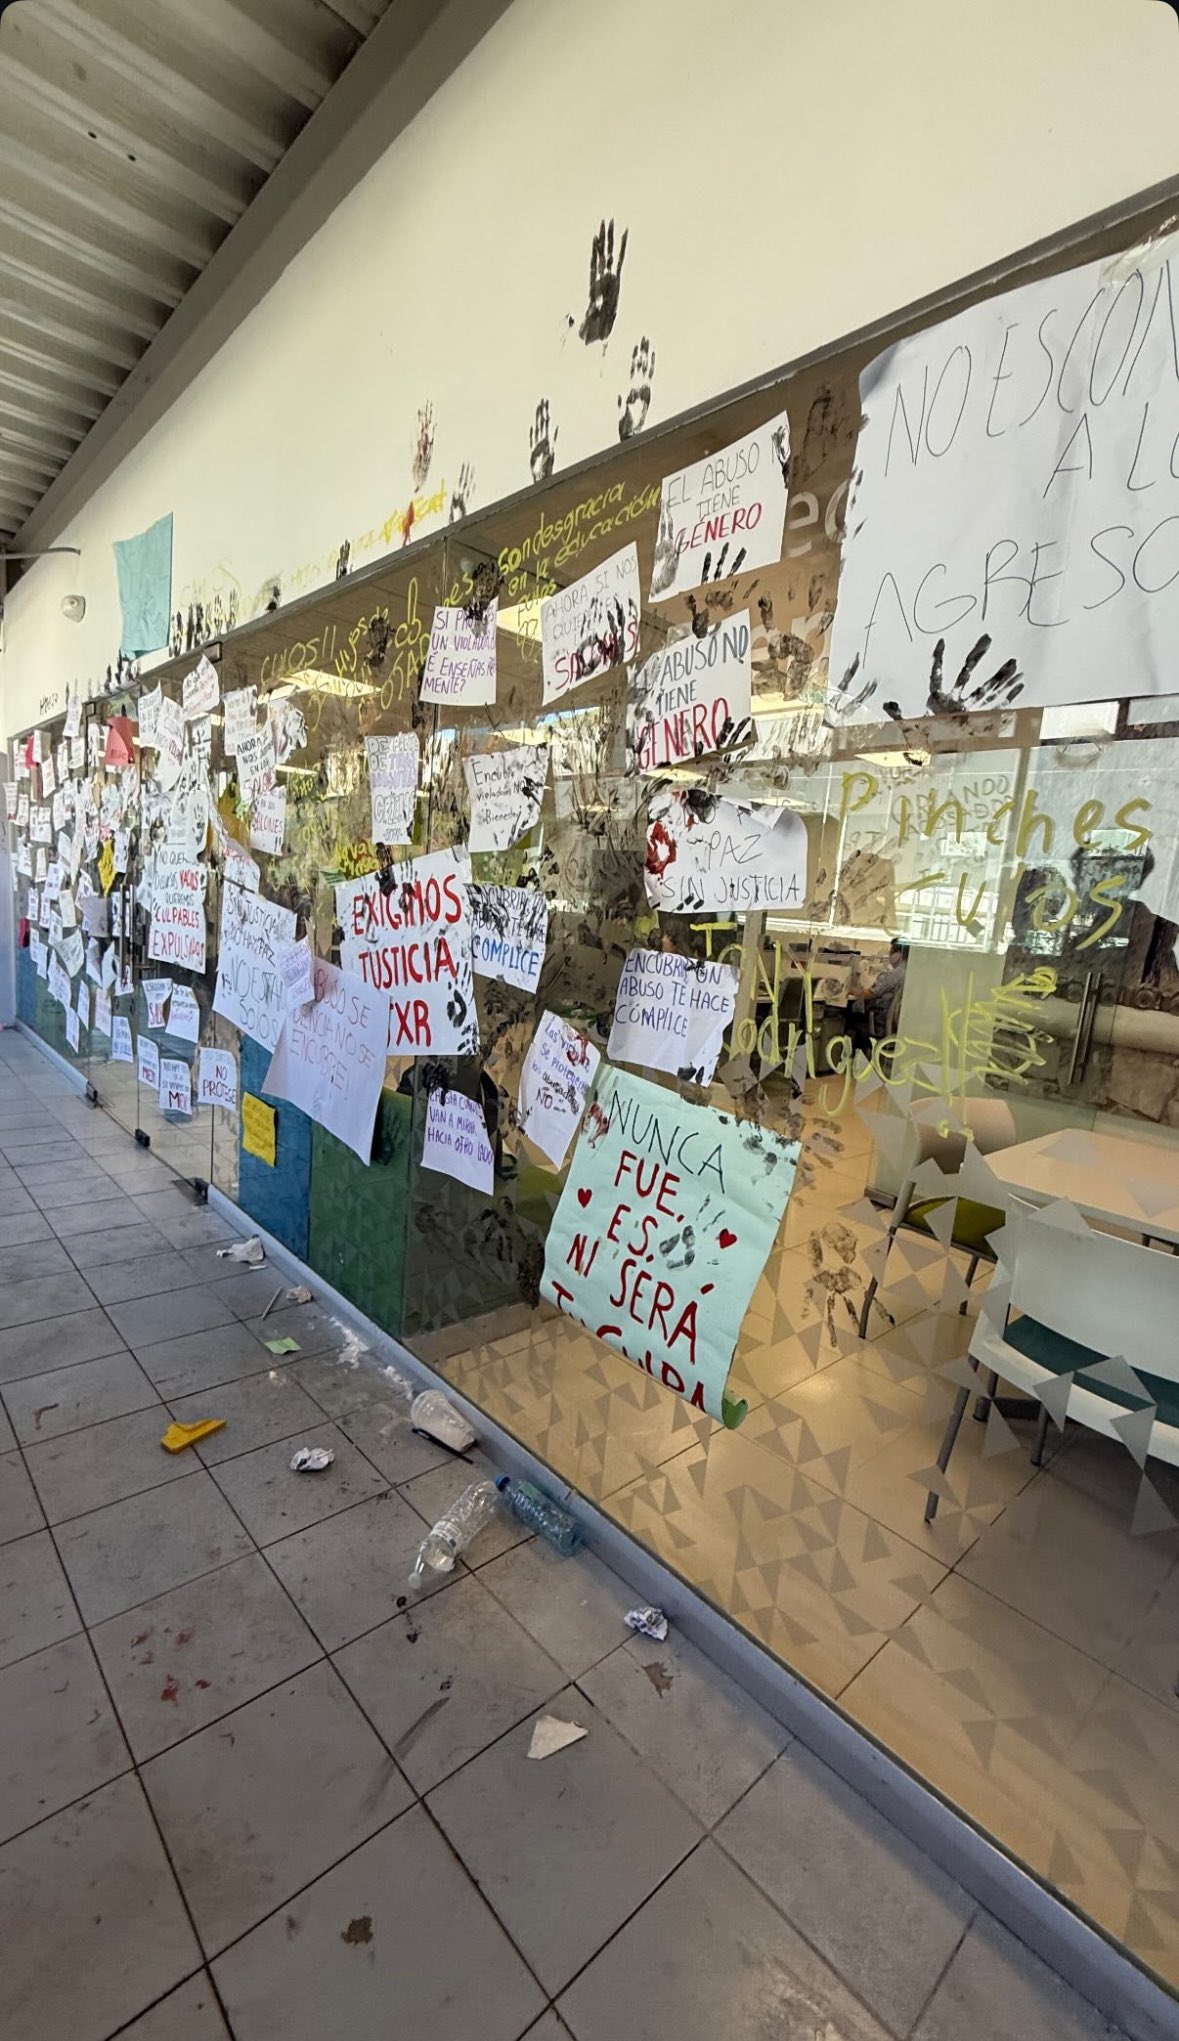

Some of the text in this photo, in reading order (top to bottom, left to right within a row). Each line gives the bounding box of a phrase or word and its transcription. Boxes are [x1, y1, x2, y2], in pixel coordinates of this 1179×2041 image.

[885, 345, 972, 477] NO
[700, 442, 760, 496] ABUSO
[1043, 402, 1179, 499] A L
[696, 484, 742, 518] TIENE
[434, 610, 449, 630] SI
[431, 632, 448, 651] UN
[660, 636, 719, 687] ABUSO
[656, 679, 698, 717] TIENE
[708, 830, 764, 871] PAZ
[662, 873, 801, 904] SIN JUSTICIA
[619, 975, 731, 1013] ABUSO TE HACE
[605, 1089, 726, 1195] NUNCA
[566, 1232, 600, 1279] NI
